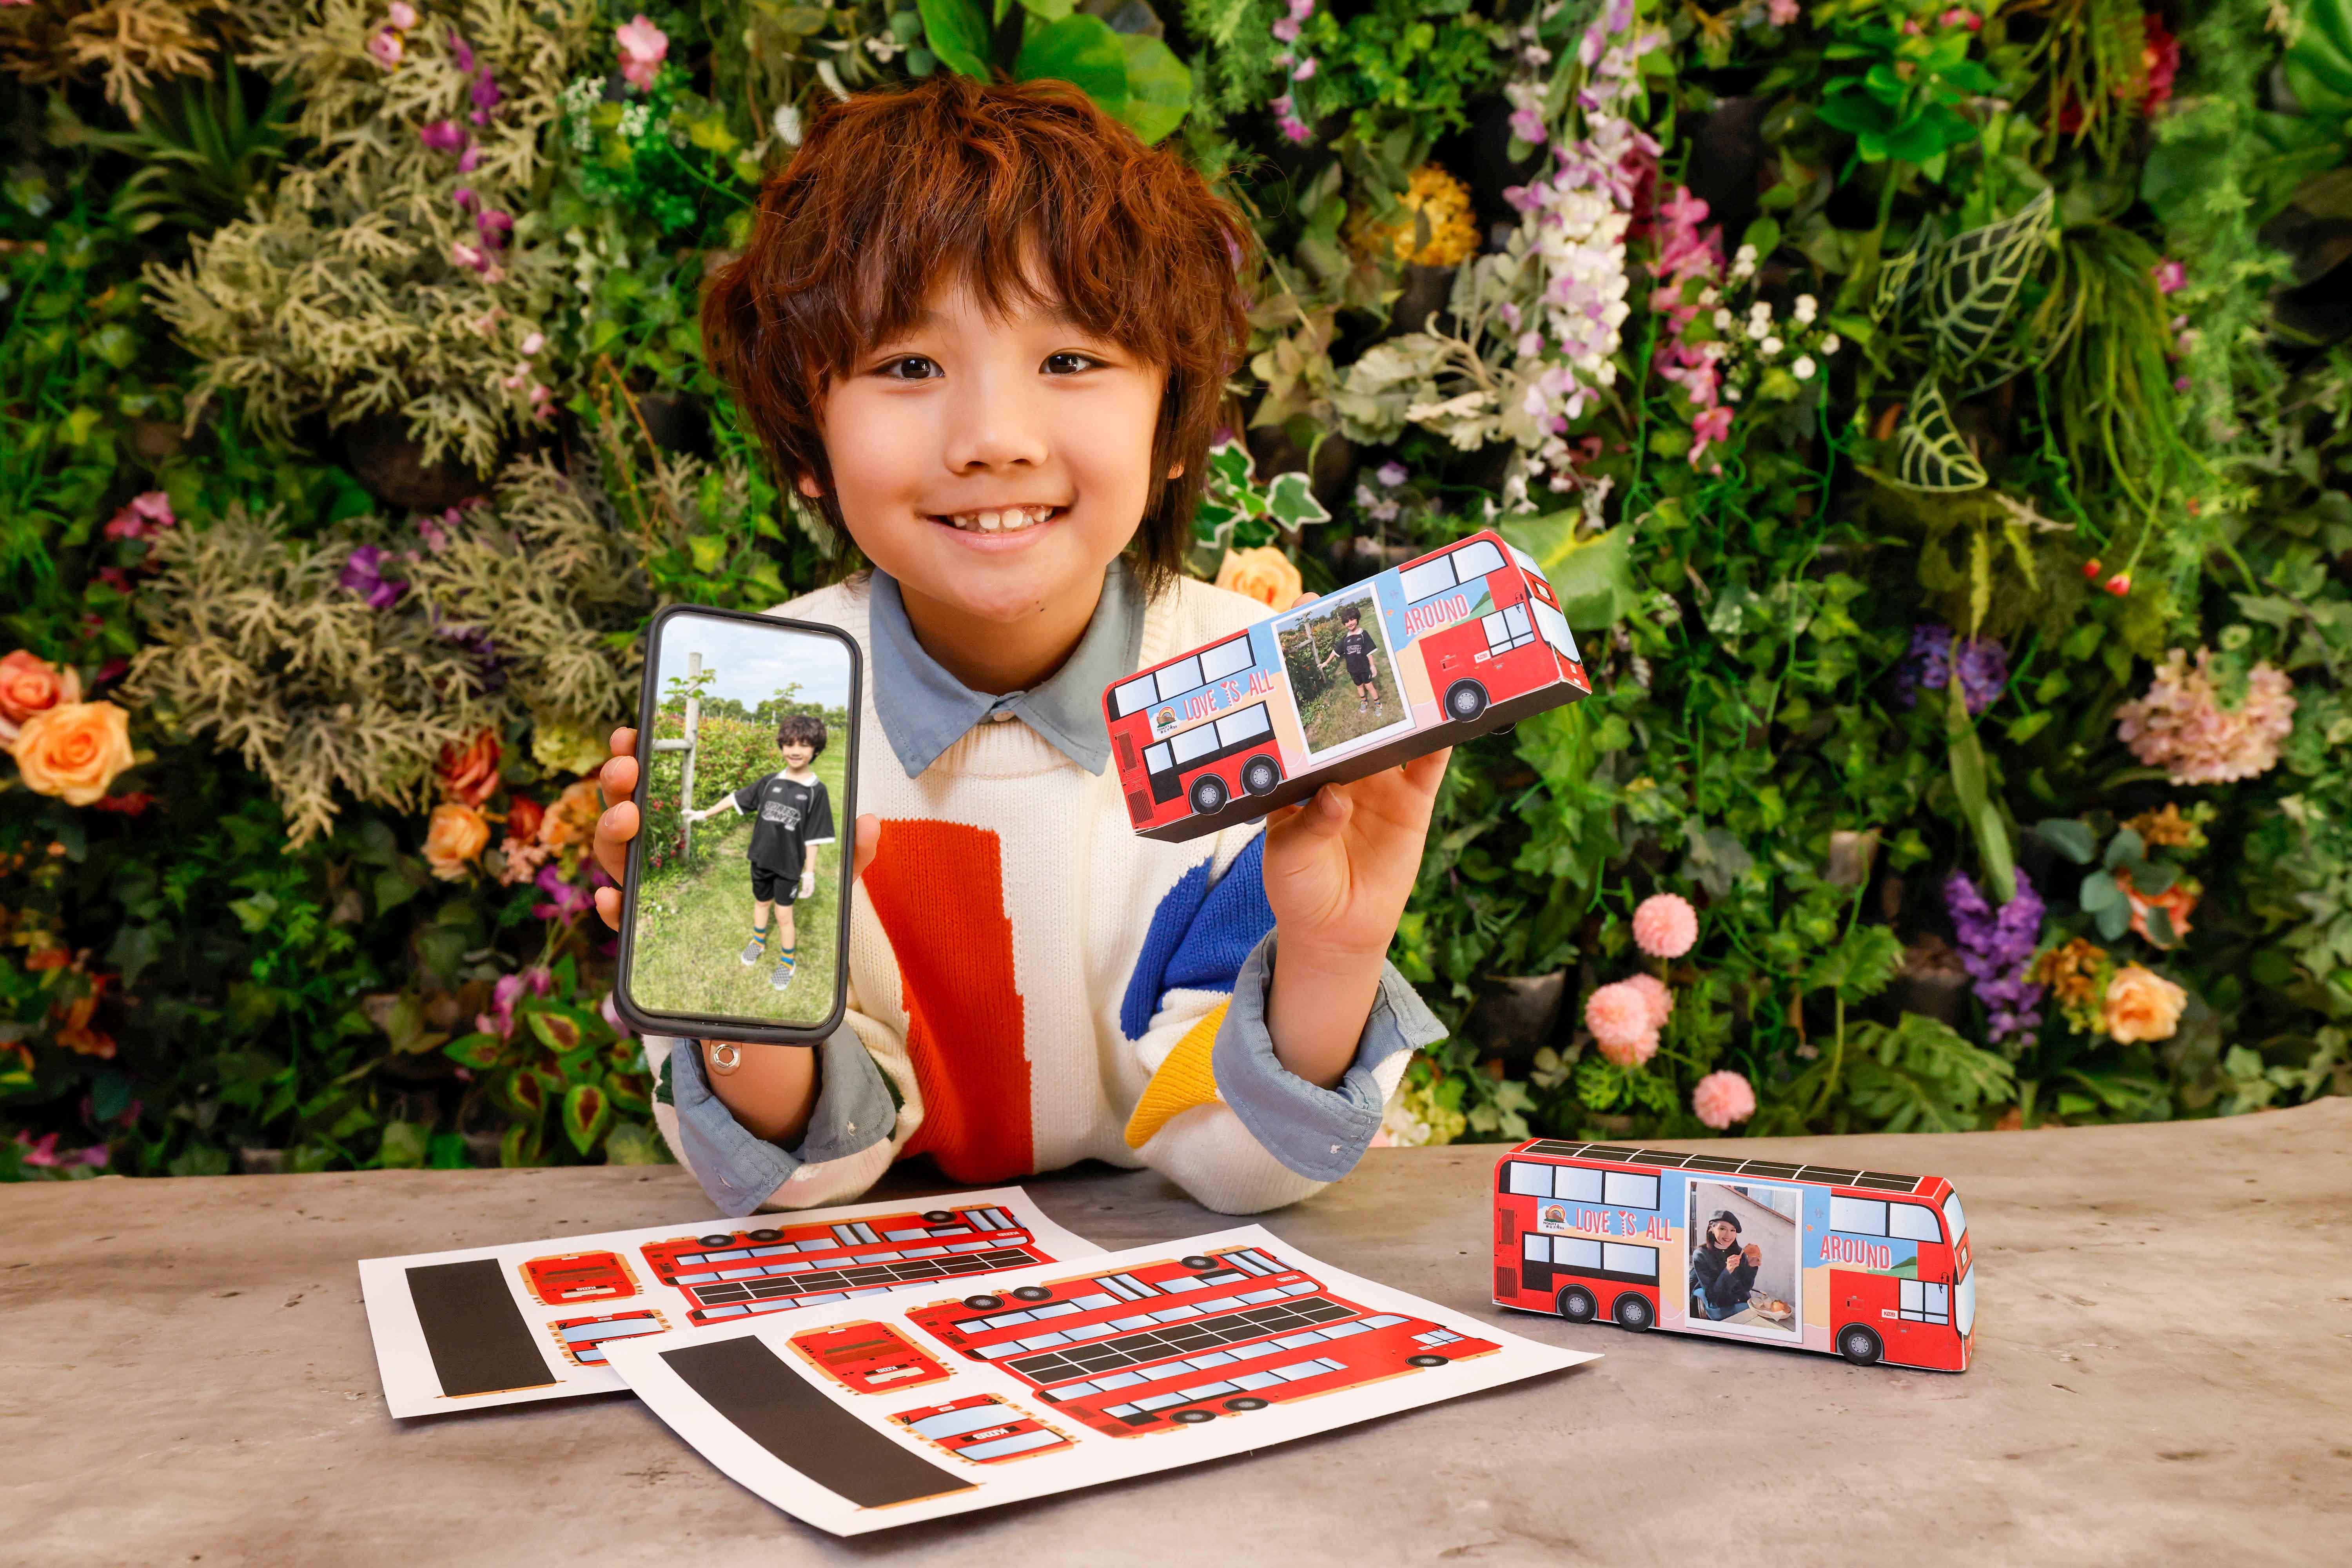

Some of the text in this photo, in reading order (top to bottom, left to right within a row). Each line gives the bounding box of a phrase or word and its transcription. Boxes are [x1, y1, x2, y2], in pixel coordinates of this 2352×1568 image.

[1183, 594, 1470, 721] LOVE IS ALL AROUND
[1576, 1207, 1891, 1270] LOVE IS ALL AROUND
[972, 1428, 1010, 1440] KMB
